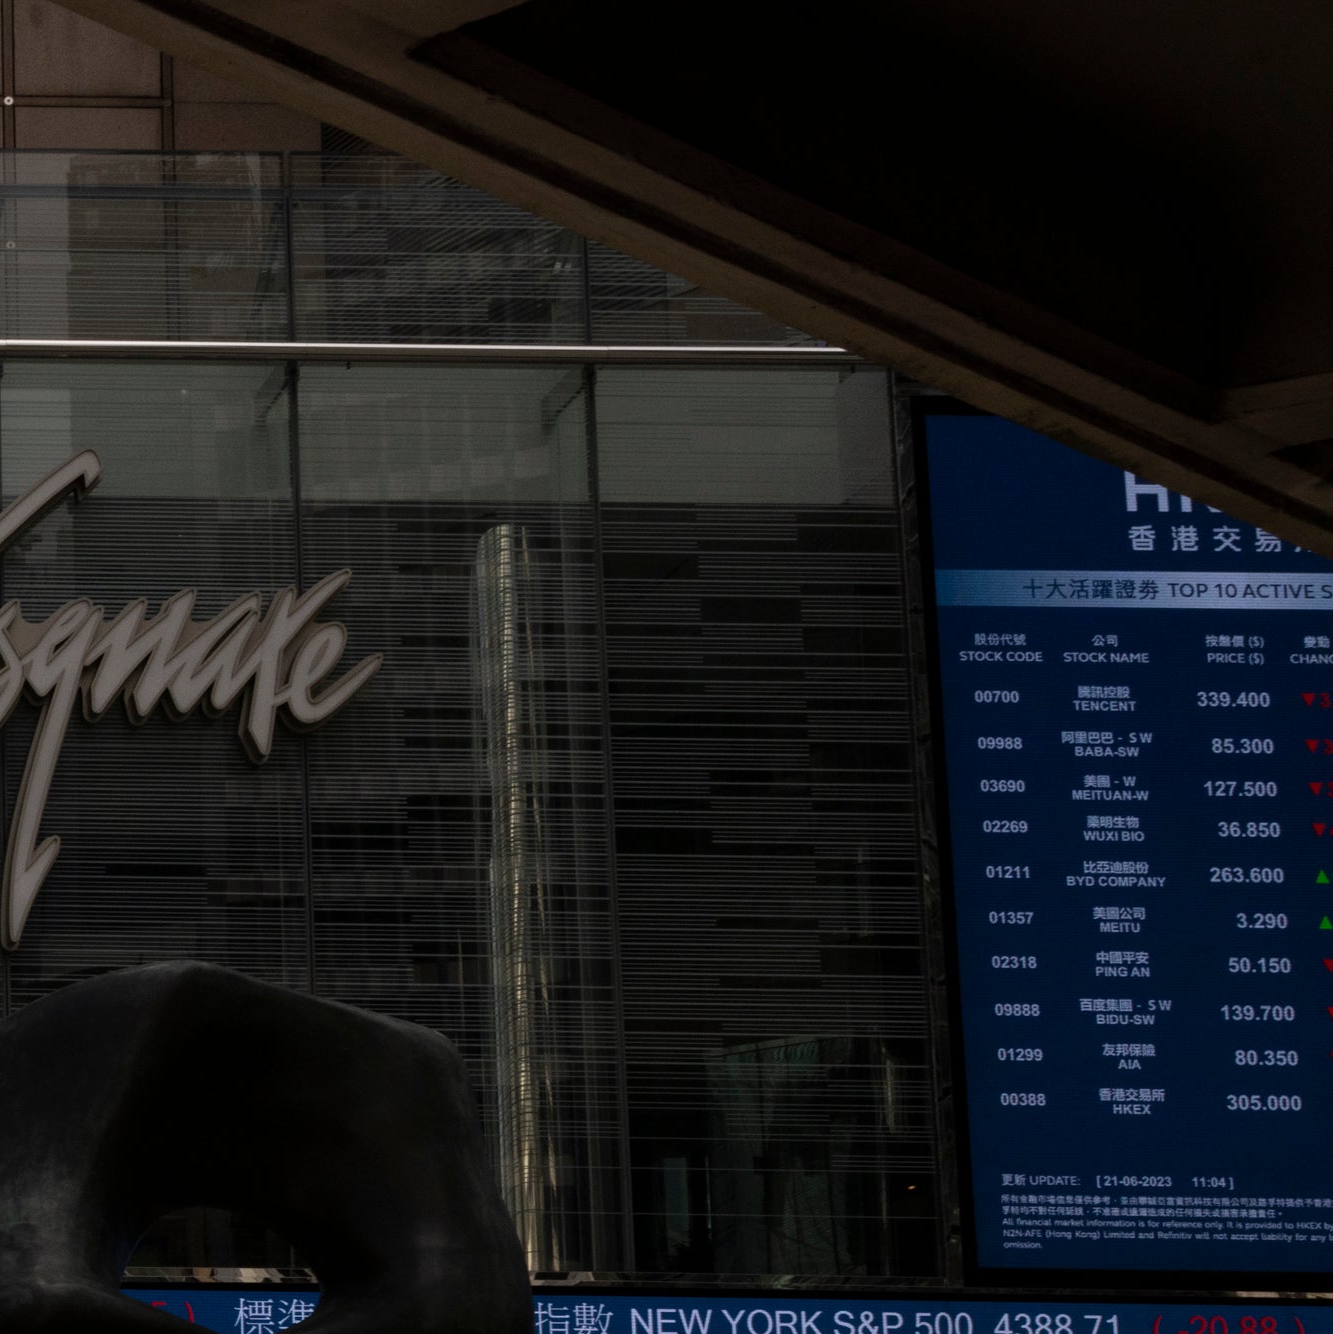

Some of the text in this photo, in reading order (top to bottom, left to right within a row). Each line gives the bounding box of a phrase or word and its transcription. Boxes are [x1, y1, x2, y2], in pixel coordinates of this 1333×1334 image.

[1129, 525, 1311, 552] 香港交易
[1167, 583, 1208, 597] TOP
[1214, 584, 1237, 598] 10
[1242, 584, 1315, 599] ACTIVE
[975, 633, 1026, 645] 股份代號
[1092, 635, 1118, 647] 公司
[959, 651, 1043, 661] STOCK CODE
[1063, 652, 1149, 663] STOCK NAME
[1207, 653, 1245, 663] PRICE
[975, 690, 1019, 703] 00700
[1198, 692, 1270, 707] 339.400
[1073, 701, 1136, 711] TENCENT
[978, 737, 1022, 749] 09988
[1212, 738, 1274, 754] 85.300
[1075, 746, 1139, 757] BABA-SW
[981, 780, 1025, 792] 03690
[1204, 781, 1277, 797] 127.500
[1072, 790, 1149, 800] MEITUAN-W
[983, 820, 1028, 833] 02269
[1218, 822, 1280, 837] 36.850
[1084, 831, 1144, 841] WUXI BIO
[986, 866, 1029, 878] 01211
[1210, 867, 1284, 883] 263.600
[1067, 876, 1165, 886] BYD COMPANY
[989, 912, 1033, 924] 01357
[1237, 913, 1288, 928] 3.290
[1100, 922, 1140, 932] MEITU
[992, 956, 1037, 968] 02318
[1229, 957, 1291, 973] 50.150
[1096, 967, 1150, 977] PING AN
[995, 1004, 1040, 1016] 09888
[1221, 1005, 1295, 1021] 139.700
[1096, 1014, 1155, 1024] BIDU-SW
[998, 1048, 1043, 1061] 01299
[1236, 1050, 1298, 1066] 80.350
[1118, 1059, 1141, 1069] AIA
[1001, 1093, 1046, 1106] 00388
[1099, 1088, 1165, 1101] 香港交易所
[1113, 1104, 1151, 1114] HKEX
[1227, 1095, 1301, 1111] 305.000
[1029, 1175, 1226, 1188] UPDATE: 21-06-2023 11:04
[631, 1308, 712, 1334] NEW
